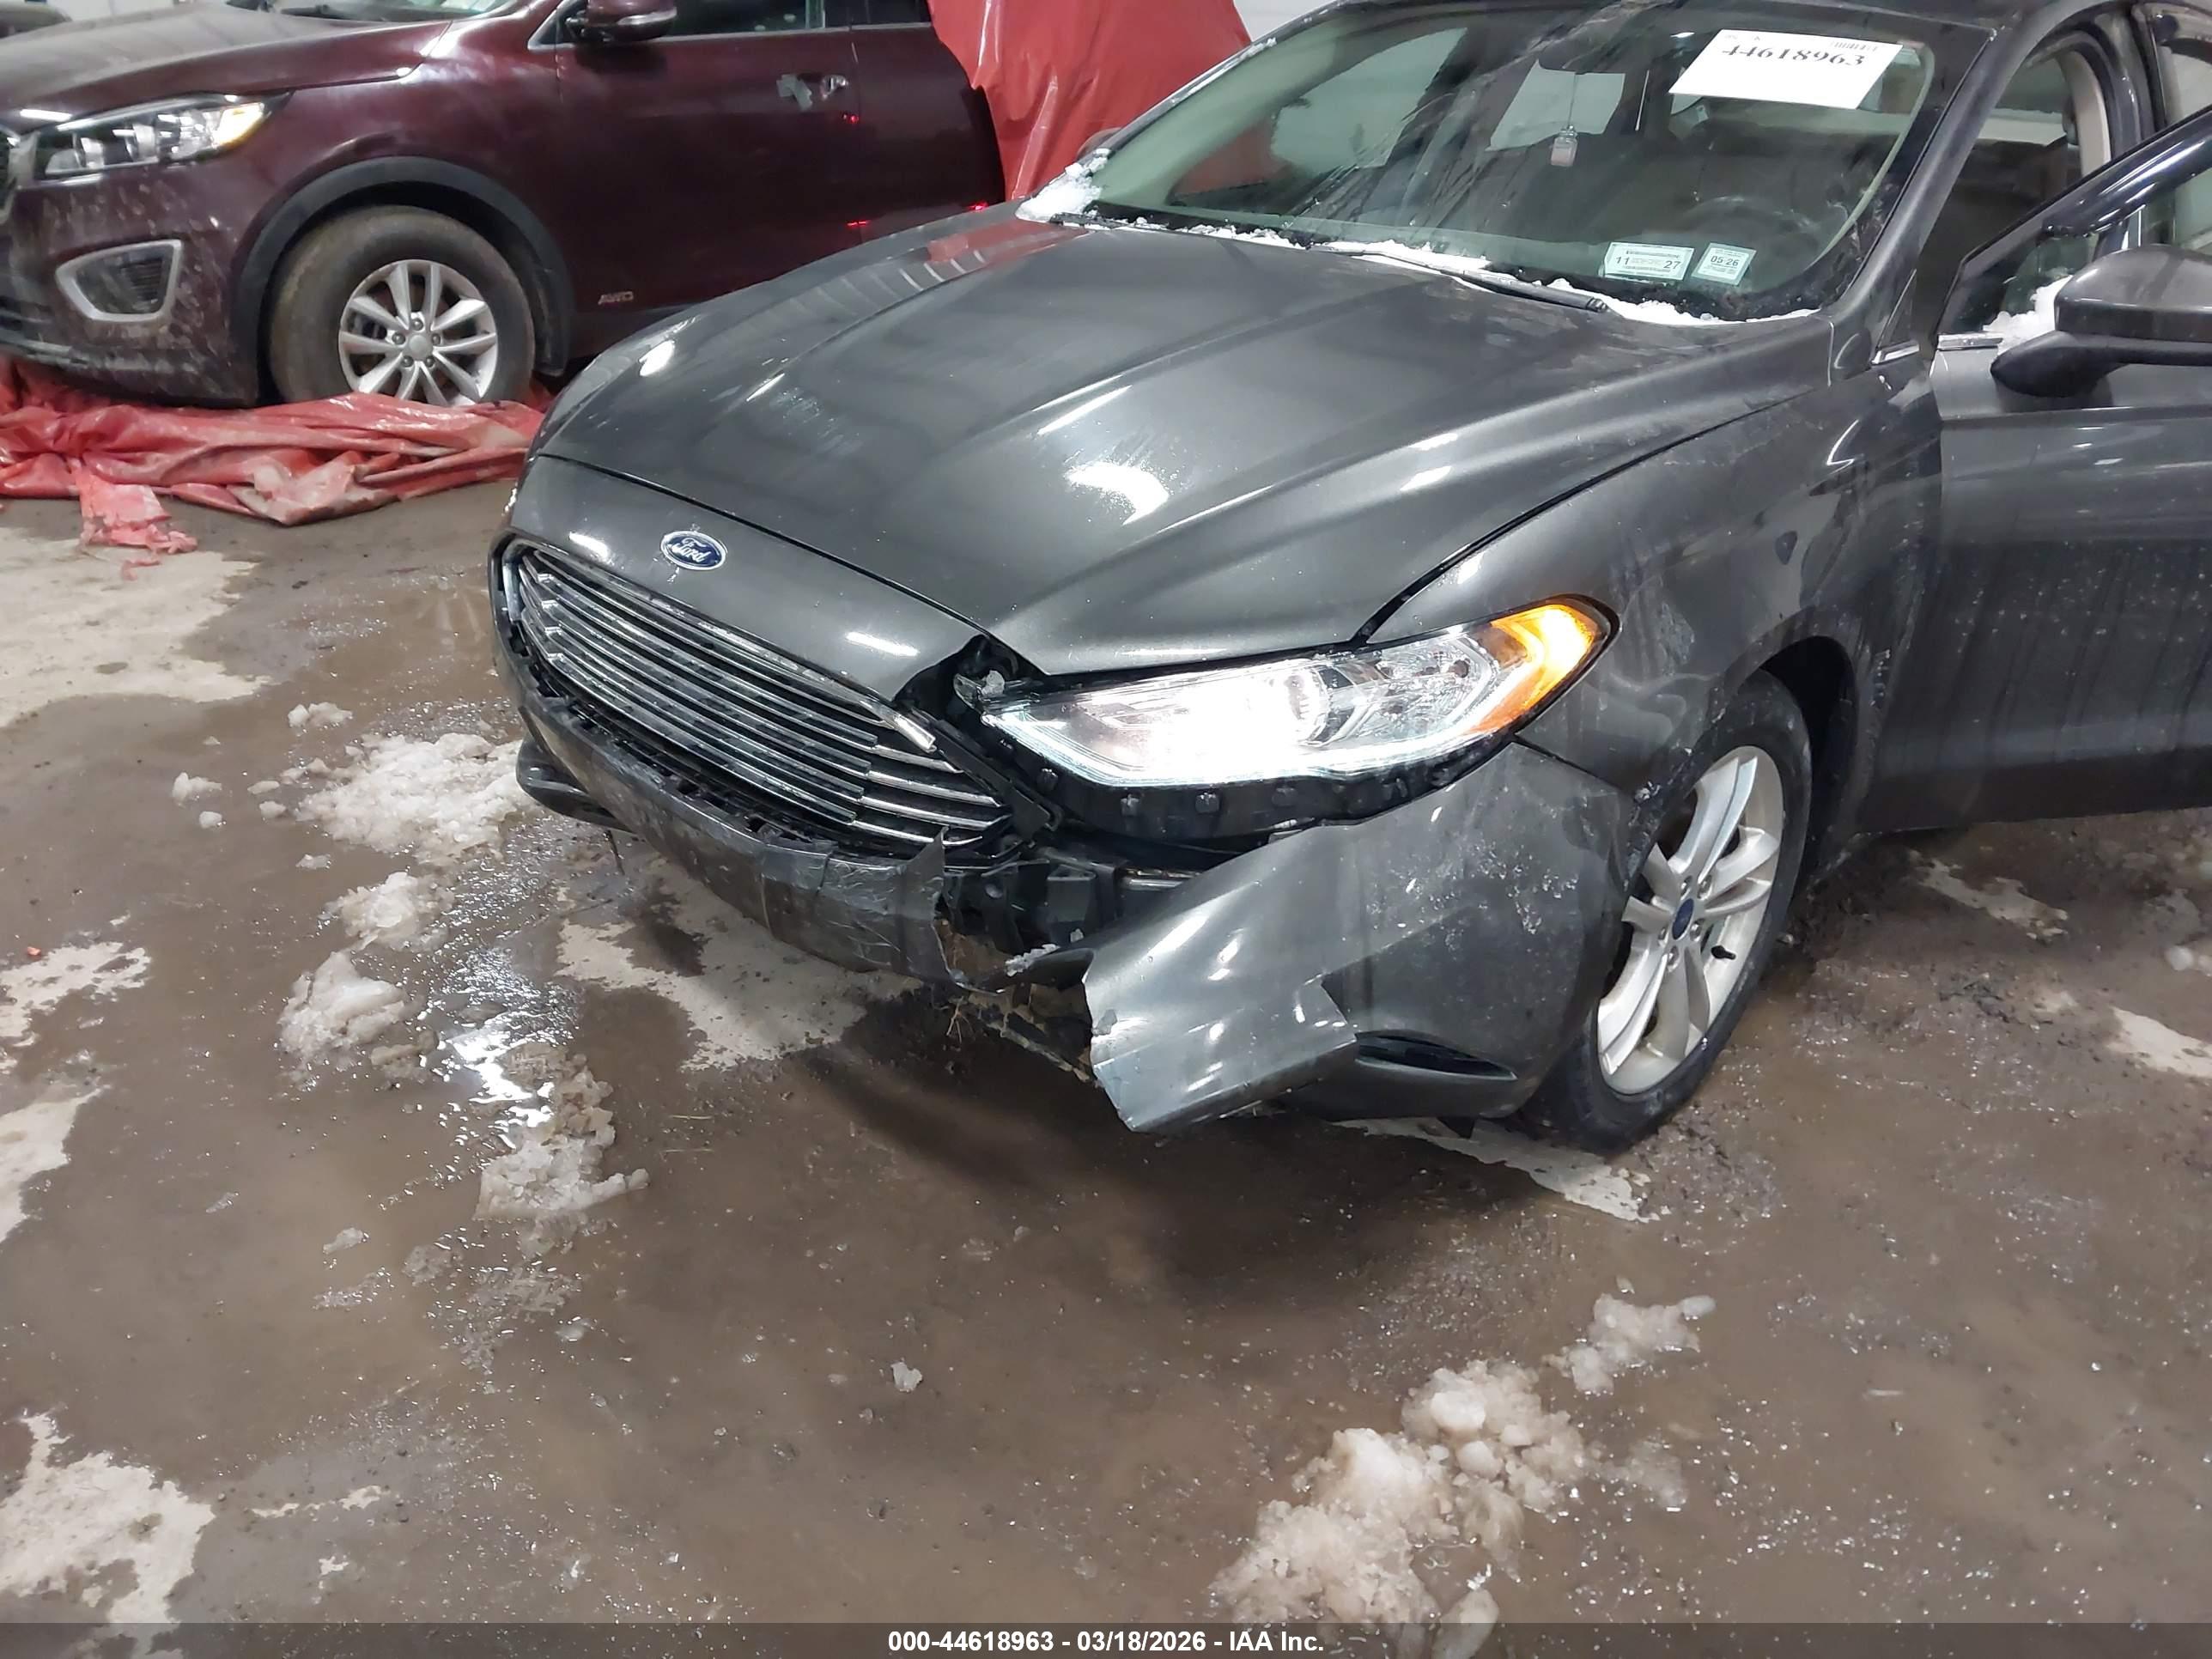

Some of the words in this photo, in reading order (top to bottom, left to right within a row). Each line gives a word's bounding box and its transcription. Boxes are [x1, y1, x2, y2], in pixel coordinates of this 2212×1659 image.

[1722, 45, 1865, 66] 44618963
[1615, 256, 1630, 265] 11
[1663, 260, 1682, 270] 27
[1711, 255, 1724, 264] 05
[1725, 258, 1741, 267] 26
[670, 537, 712, 562] Ford
